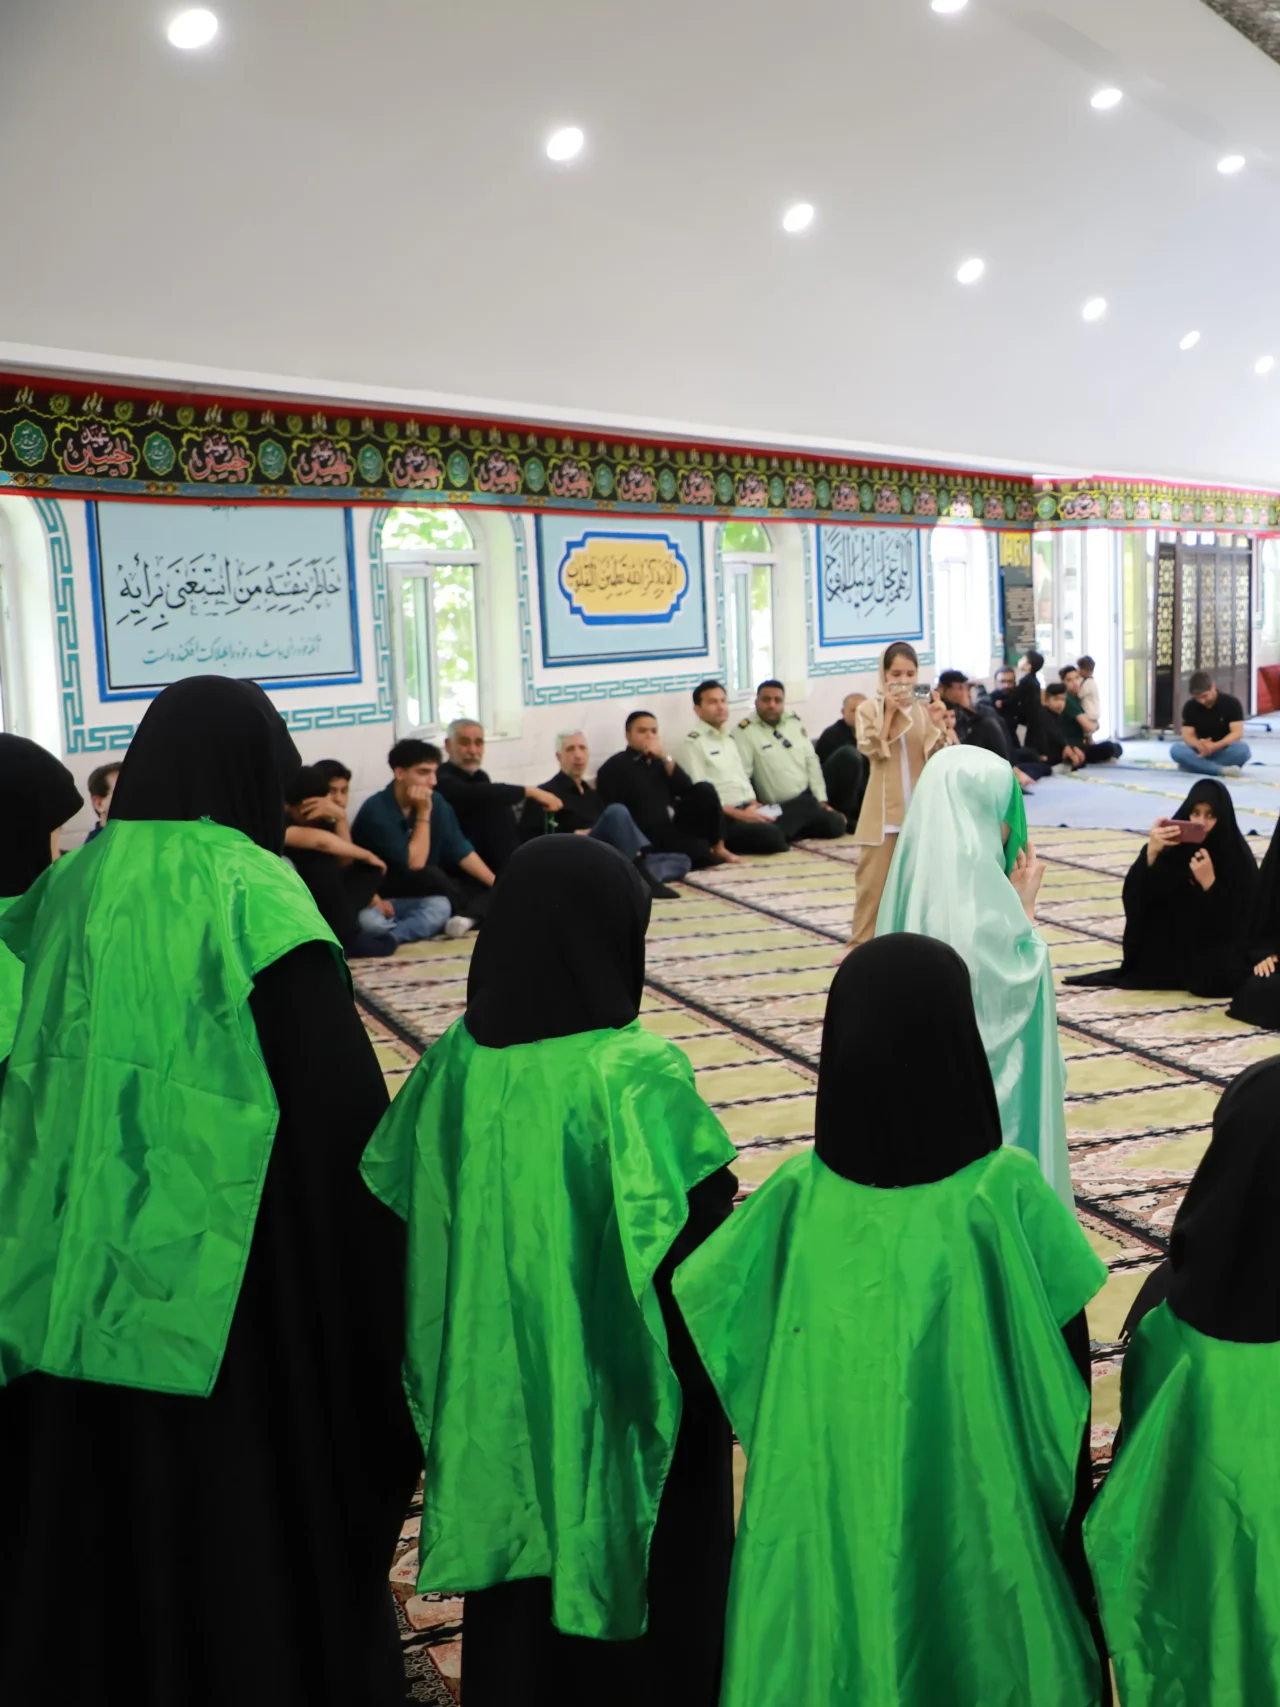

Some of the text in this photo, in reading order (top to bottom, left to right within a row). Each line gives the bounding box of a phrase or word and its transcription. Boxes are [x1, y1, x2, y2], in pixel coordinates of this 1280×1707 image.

[233, 566, 263, 613] من
[266, 560, 308, 612] بنفسه
[305, 558, 342, 607] خاطر
